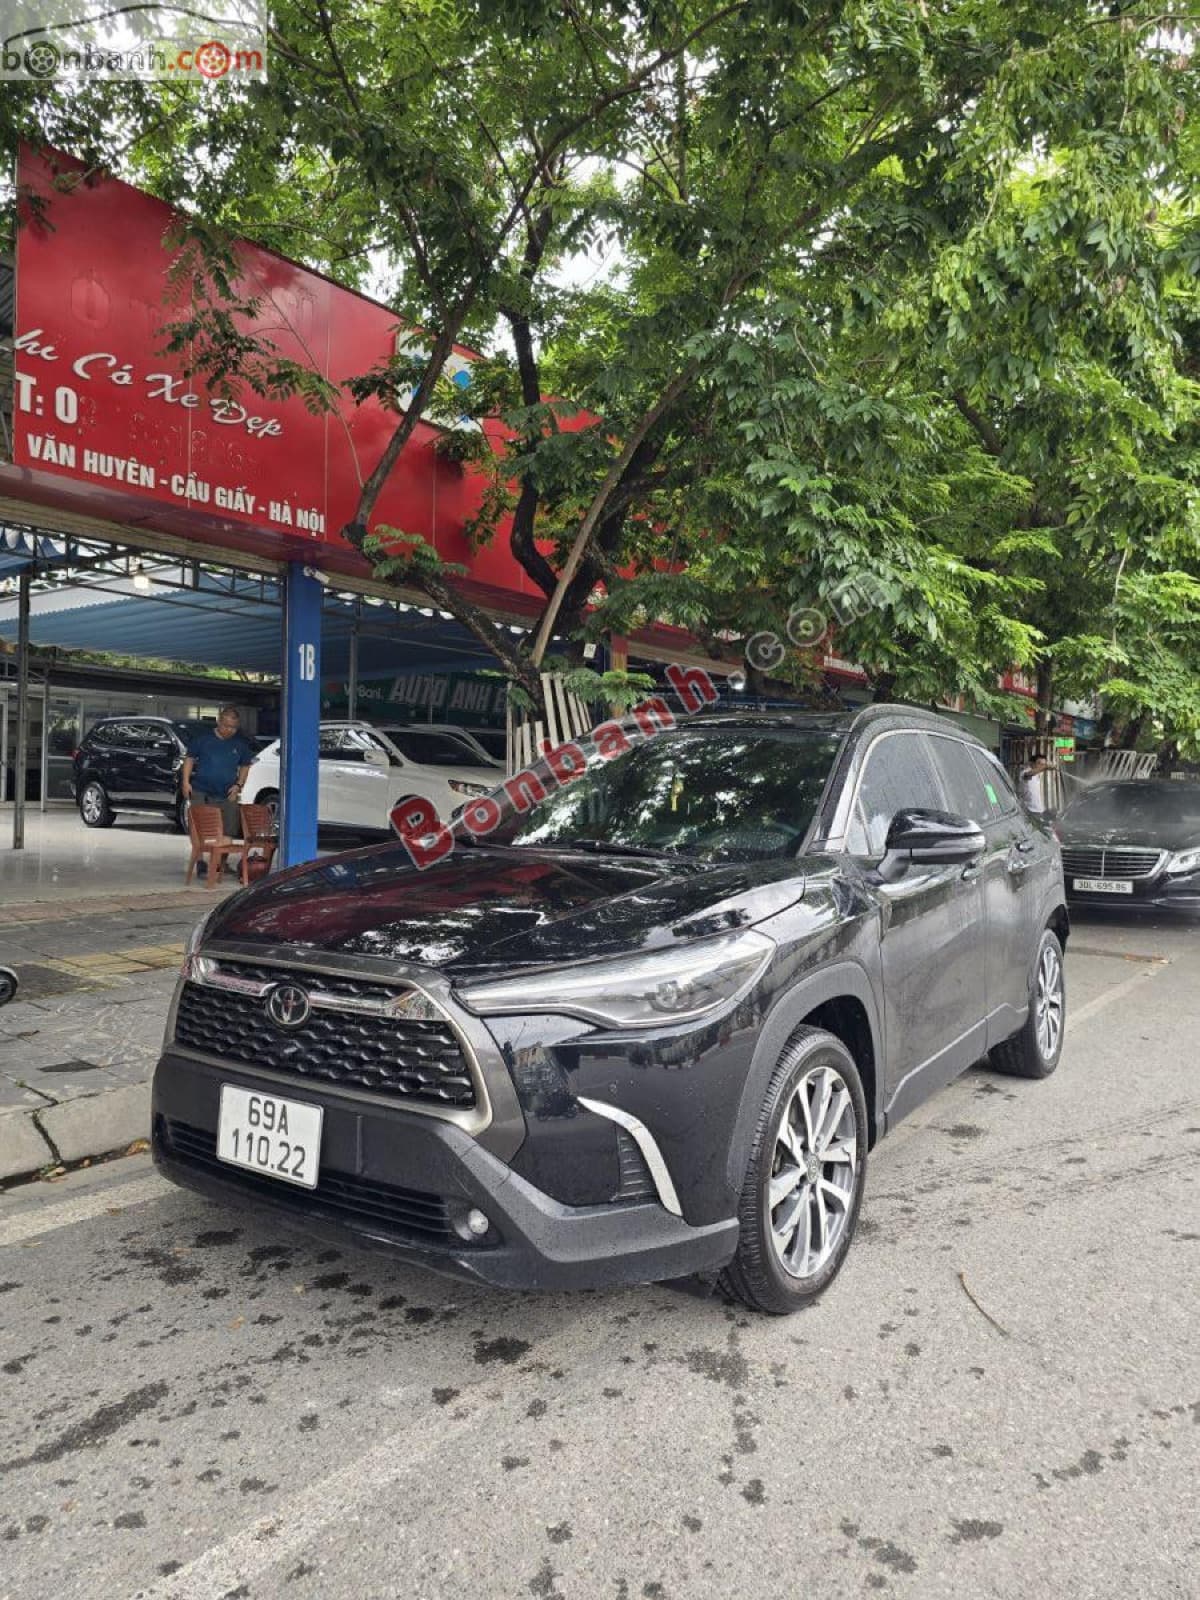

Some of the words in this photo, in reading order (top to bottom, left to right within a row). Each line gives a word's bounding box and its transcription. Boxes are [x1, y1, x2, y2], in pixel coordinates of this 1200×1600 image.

[73, 352, 134, 386] Có
[145, 373, 199, 408] Xe
[209, 398, 283, 438] Đẹp
[27, 432, 76, 468] VĂN
[83, 449, 156, 489] HUYÊN
[171, 471, 210, 503] CẦU
[215, 486, 256, 514] GIẤY
[269, 500, 293, 525] HÀ
[296, 507, 325, 537] NỘI
[298, 643, 316, 681] 1B
[248, 1095, 289, 1136] 69A
[231, 1127, 306, 1178] 110.22
